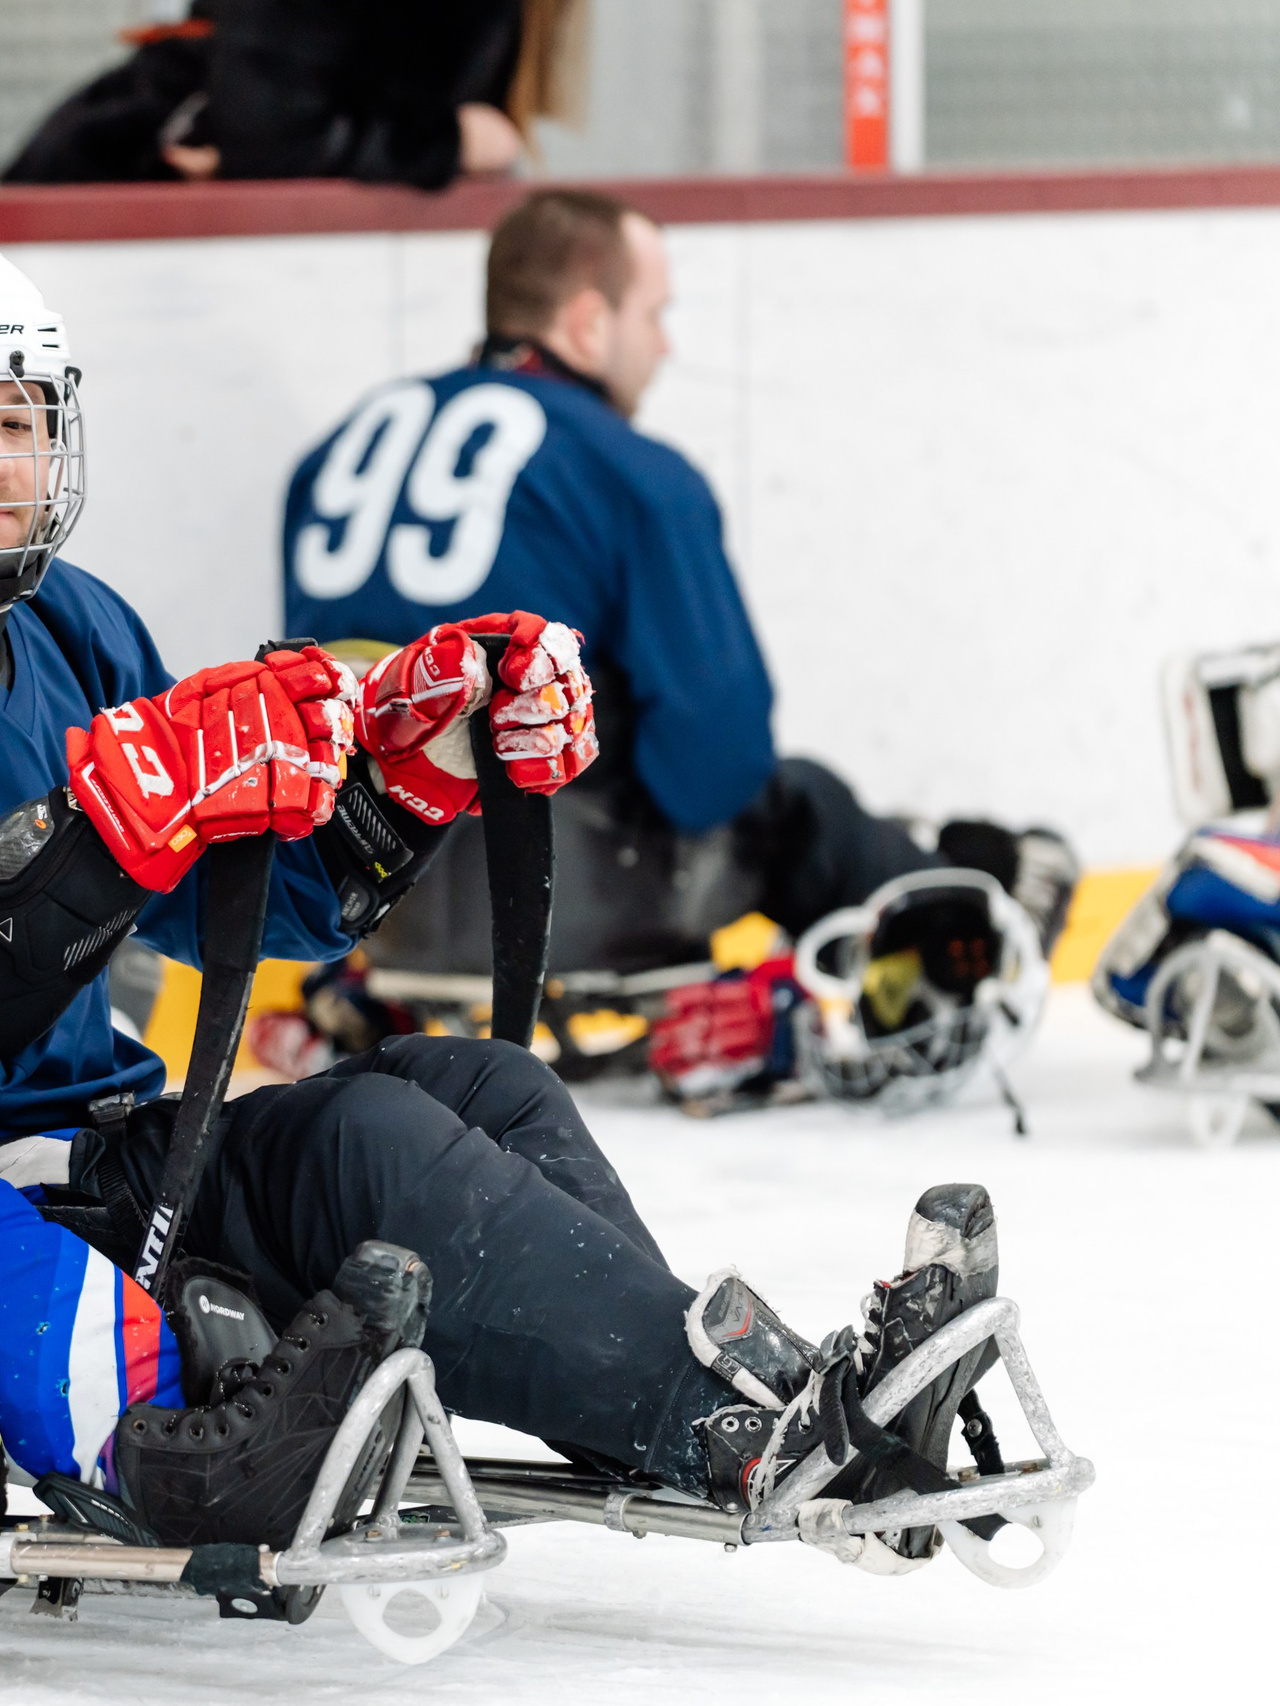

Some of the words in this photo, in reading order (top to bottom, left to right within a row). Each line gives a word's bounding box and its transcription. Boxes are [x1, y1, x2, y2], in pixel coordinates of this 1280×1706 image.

[293, 379, 547, 606] 99
[388, 784, 444, 821] CCM
[210, 1303, 245, 1321] NORDWAY
